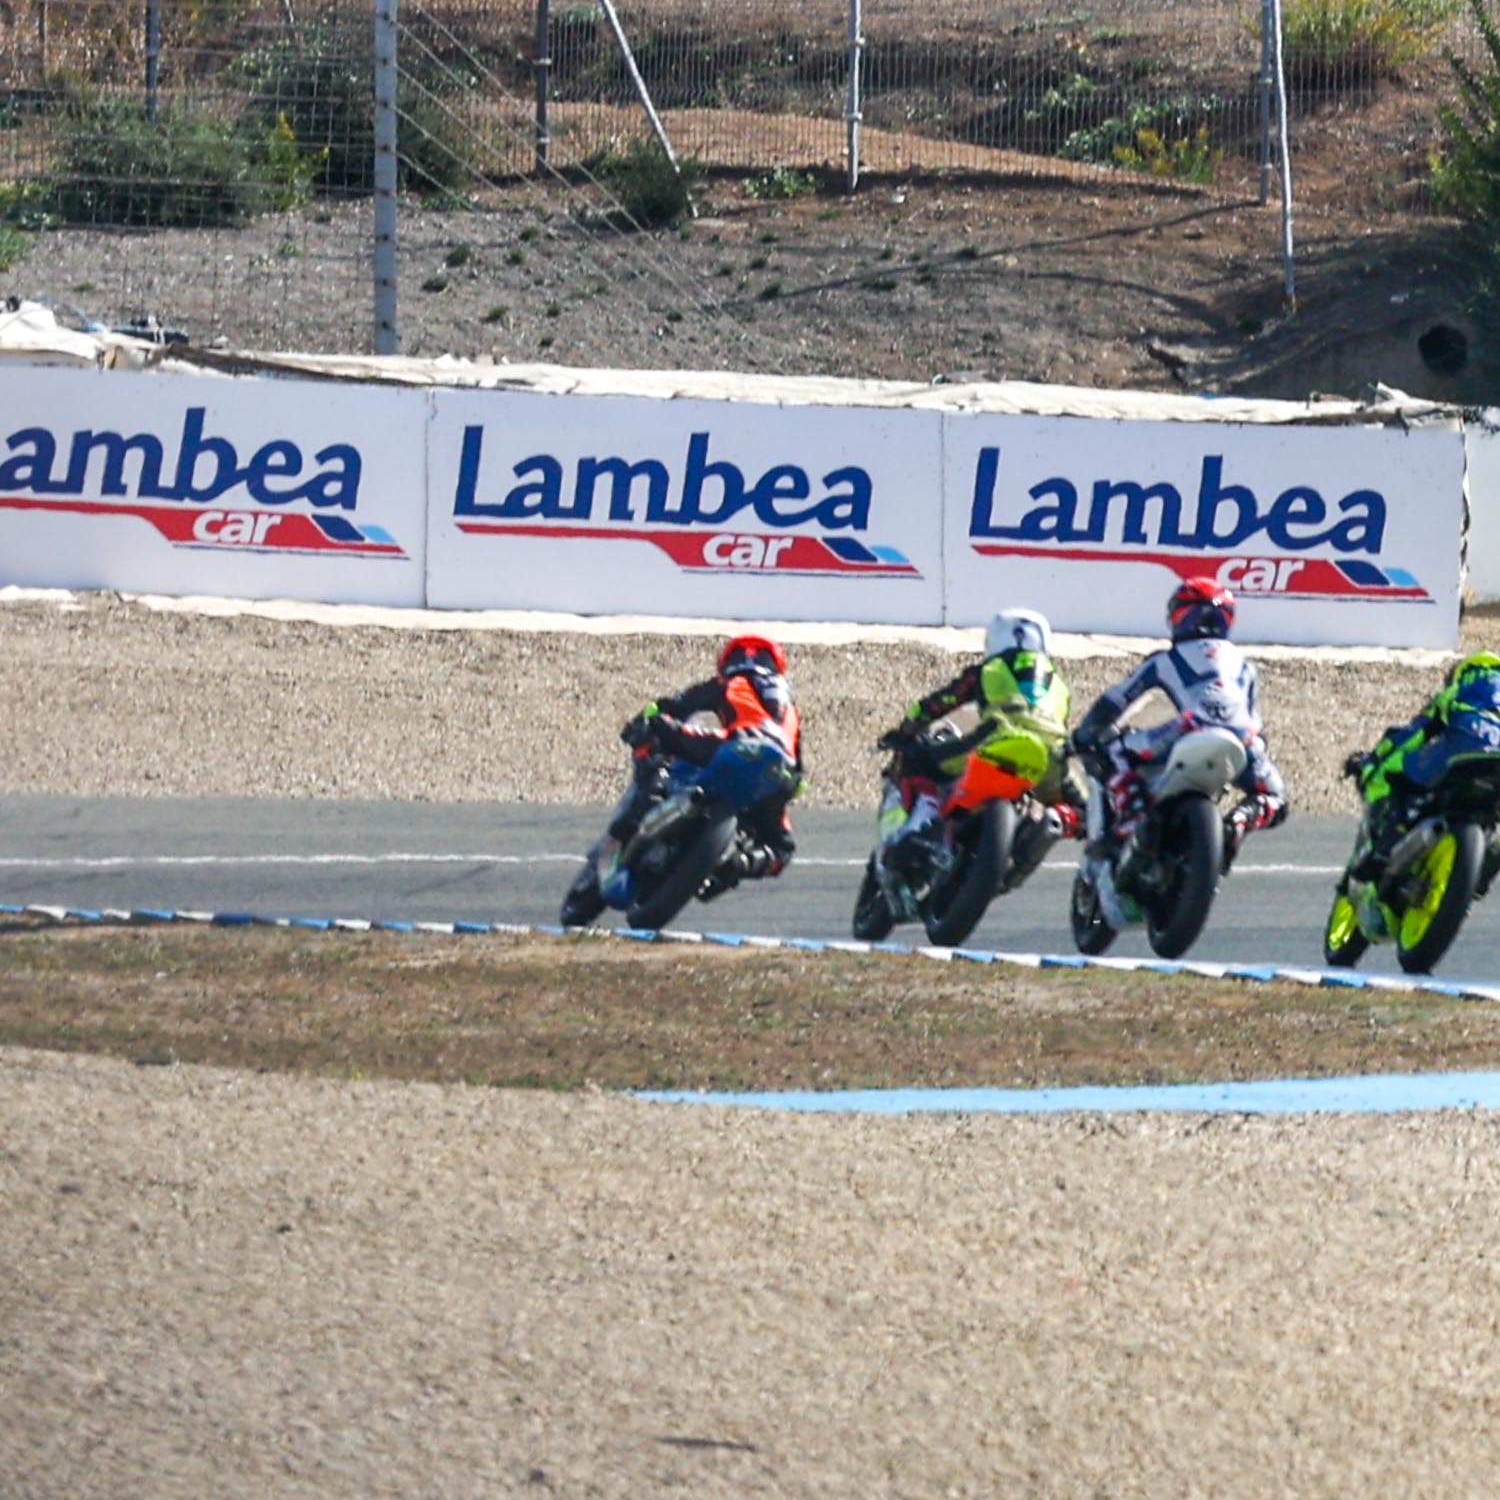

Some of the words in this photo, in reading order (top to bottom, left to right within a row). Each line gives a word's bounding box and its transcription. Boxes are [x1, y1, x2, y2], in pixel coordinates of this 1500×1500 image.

[0, 407, 362, 511] ambea
[453, 424, 873, 531] Lambea
[192, 510, 282, 545] car
[968, 446, 1387, 555] Lambea
[702, 533, 794, 568] car
[1215, 556, 1305, 591] car
